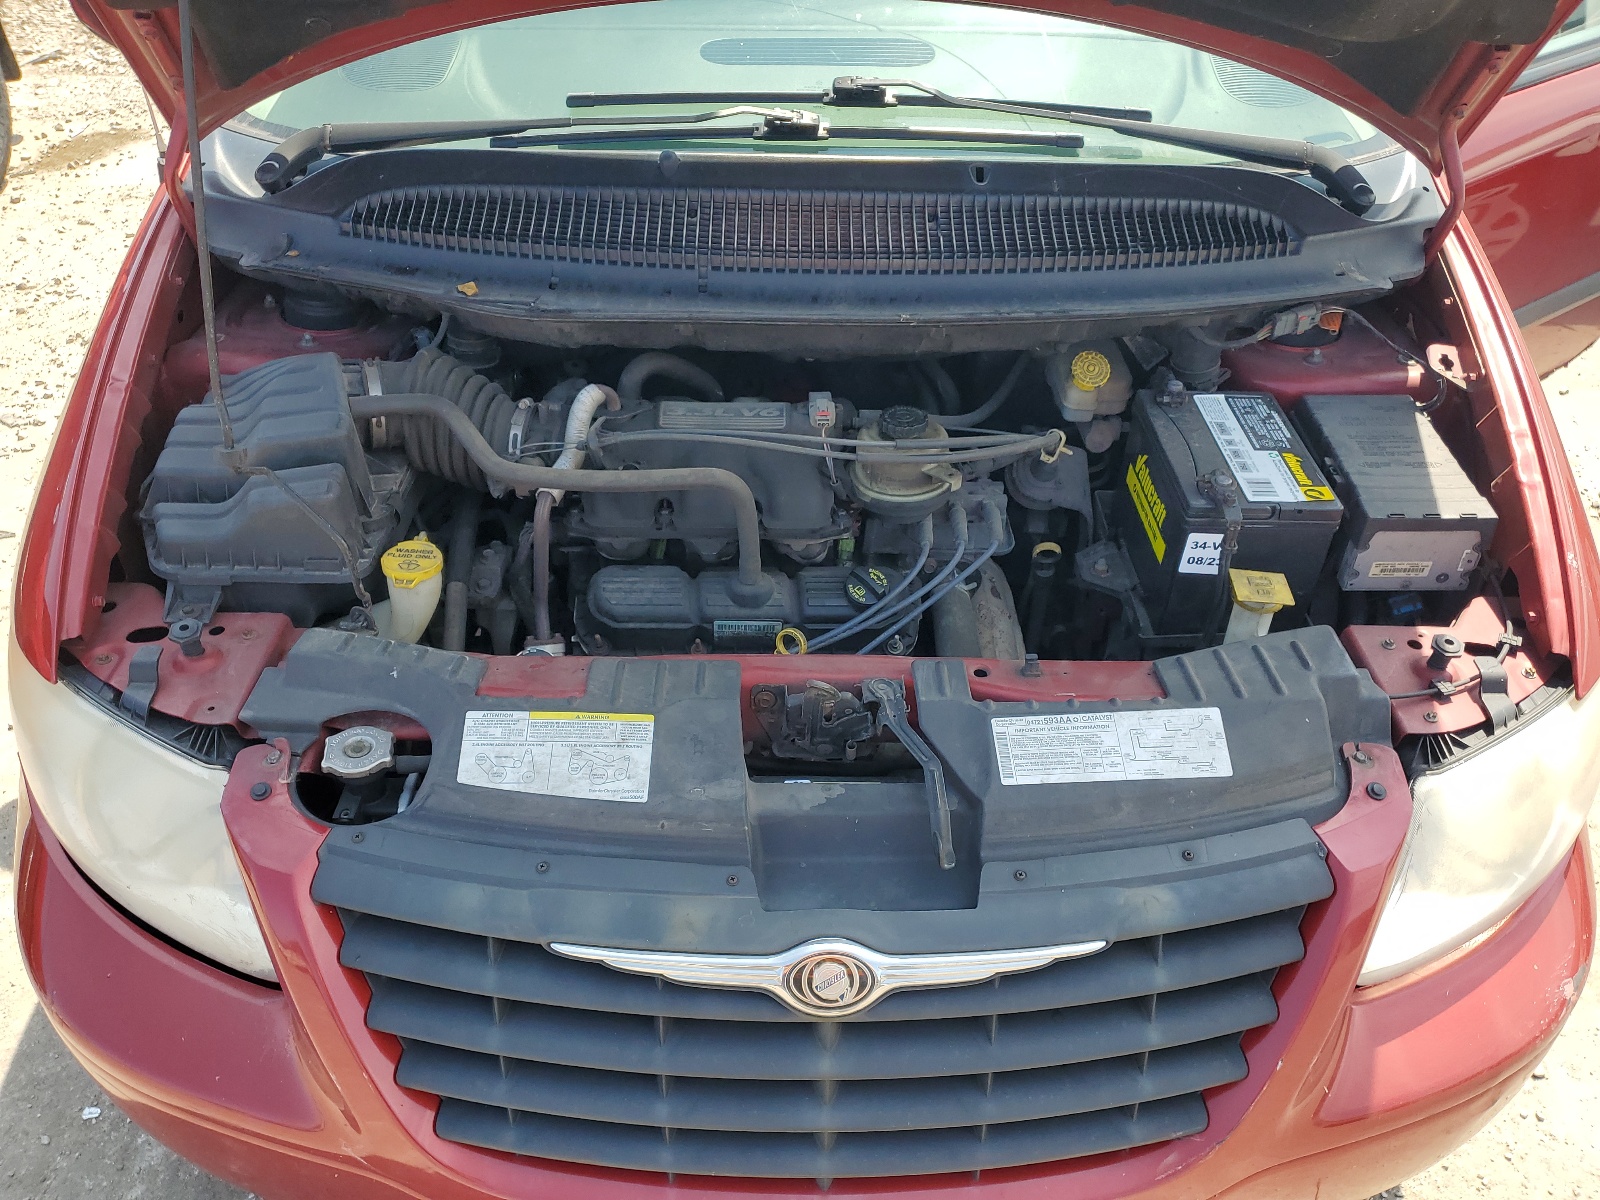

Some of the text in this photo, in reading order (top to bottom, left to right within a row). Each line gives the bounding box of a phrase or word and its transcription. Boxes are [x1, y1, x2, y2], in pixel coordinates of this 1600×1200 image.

[740, 407, 781, 417] V6
[1135, 454, 1167, 530] Valucraft
[1081, 714, 1112, 722] CATALYST
[817, 970, 845, 992] CHRYSLER
